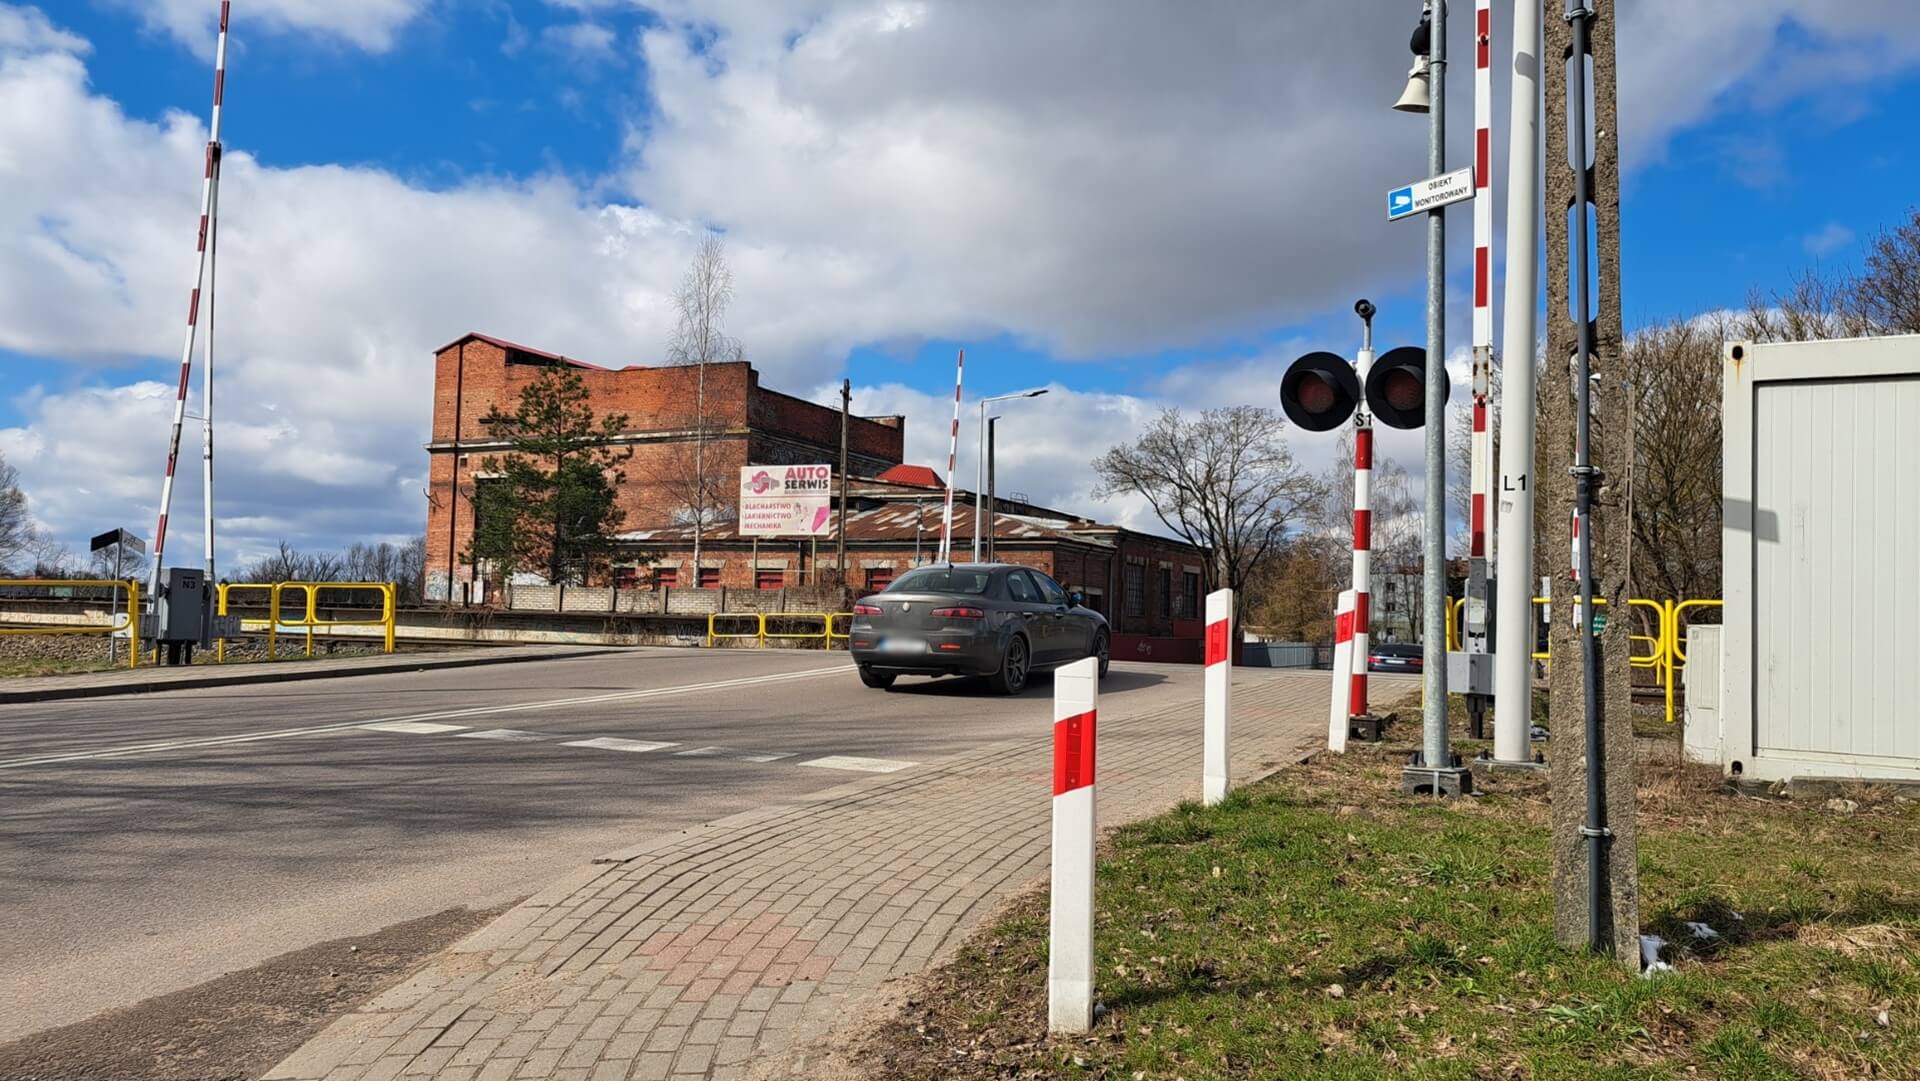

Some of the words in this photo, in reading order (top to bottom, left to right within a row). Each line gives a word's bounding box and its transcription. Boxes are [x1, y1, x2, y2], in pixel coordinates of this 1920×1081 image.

[1428, 177, 1452, 190] OBIEKT
[1415, 186, 1468, 207] MONITOROWANY
[1355, 413, 1372, 427] S1
[785, 467, 829, 479] AUTO
[785, 480, 829, 489] SERWIS
[1504, 474, 1526, 491] L1
[182, 580, 196, 590] N3
